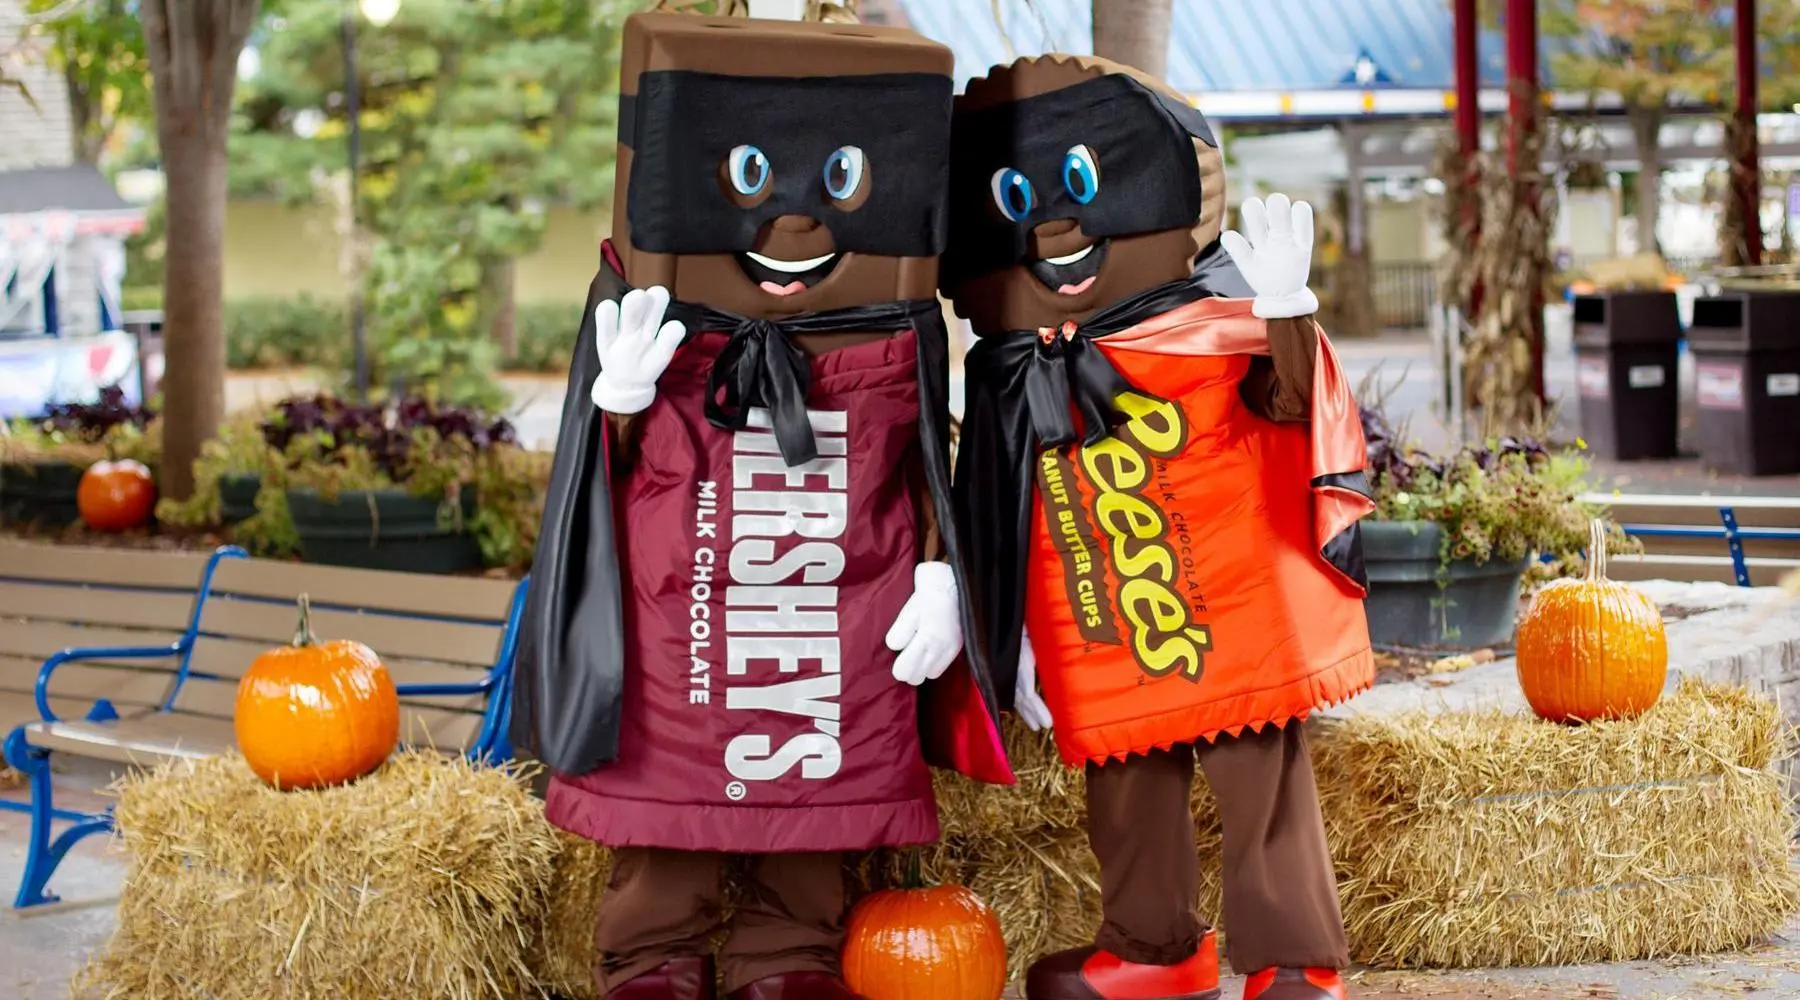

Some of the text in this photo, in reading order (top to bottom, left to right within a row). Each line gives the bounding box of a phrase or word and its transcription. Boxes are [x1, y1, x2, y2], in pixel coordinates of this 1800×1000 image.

[689, 480, 717, 706] MILK CHOCOLATE
[725, 407, 848, 781] HERSHEY'S
[1042, 447, 1069, 505] EANUT
[1058, 509, 1092, 576] BUTTER
[1077, 579, 1102, 628] CUPS
[1156, 460, 1208, 613] MILK CHOCOLATE
